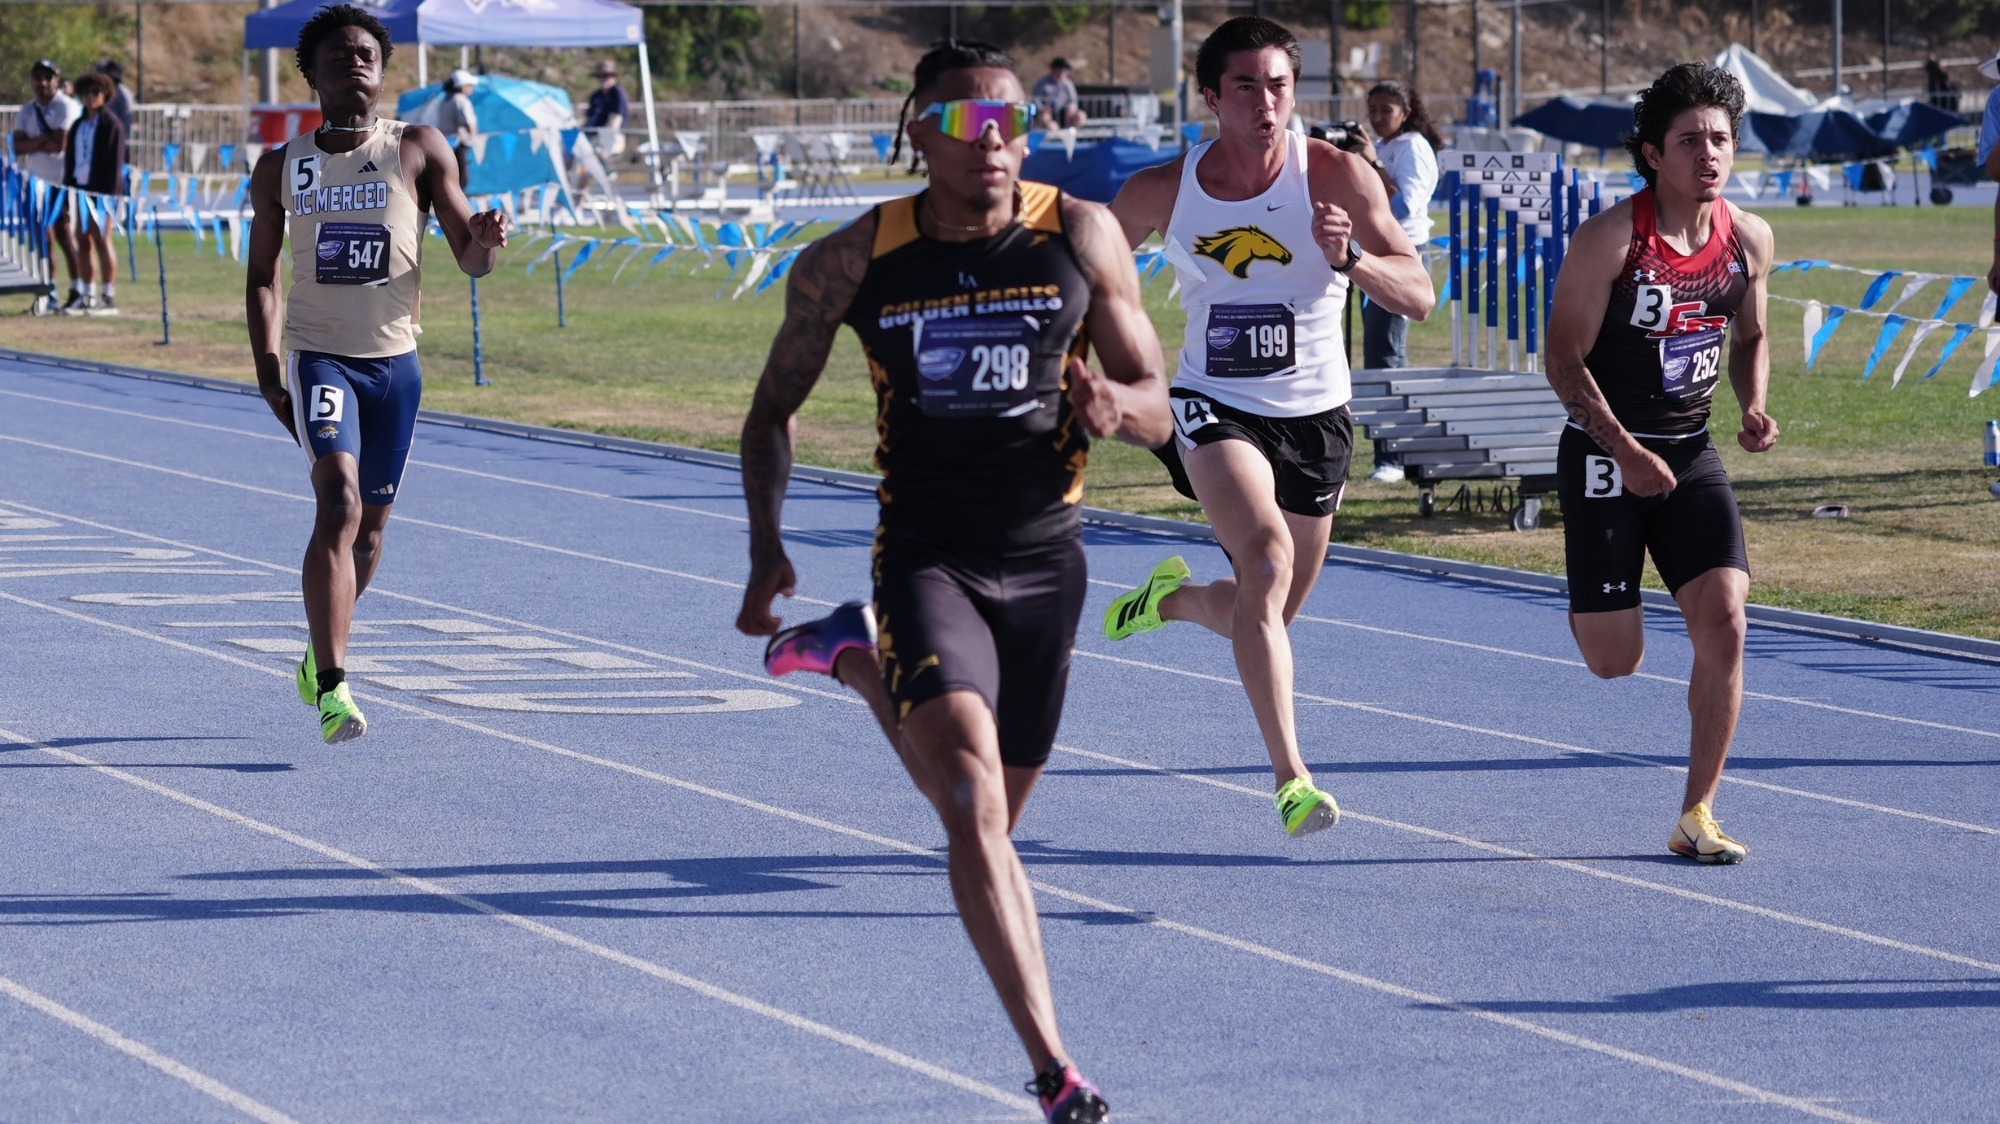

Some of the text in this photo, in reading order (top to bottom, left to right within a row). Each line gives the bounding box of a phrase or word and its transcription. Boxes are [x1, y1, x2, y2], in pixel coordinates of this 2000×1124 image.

[297, 157, 314, 191] 5
[293, 181, 388, 216] UC MERCED
[348, 240, 385, 269] 547
[878, 284, 1064, 330] GOLDEN EAGLES
[1638, 288, 1664, 328] 3
[1245, 324, 1288, 358] 199
[971, 344, 1030, 391] 298
[1691, 345, 1720, 384] 252
[317, 387, 337, 418] 5
[1184, 401, 1209, 424] 4
[1592, 459, 1615, 496] 3
